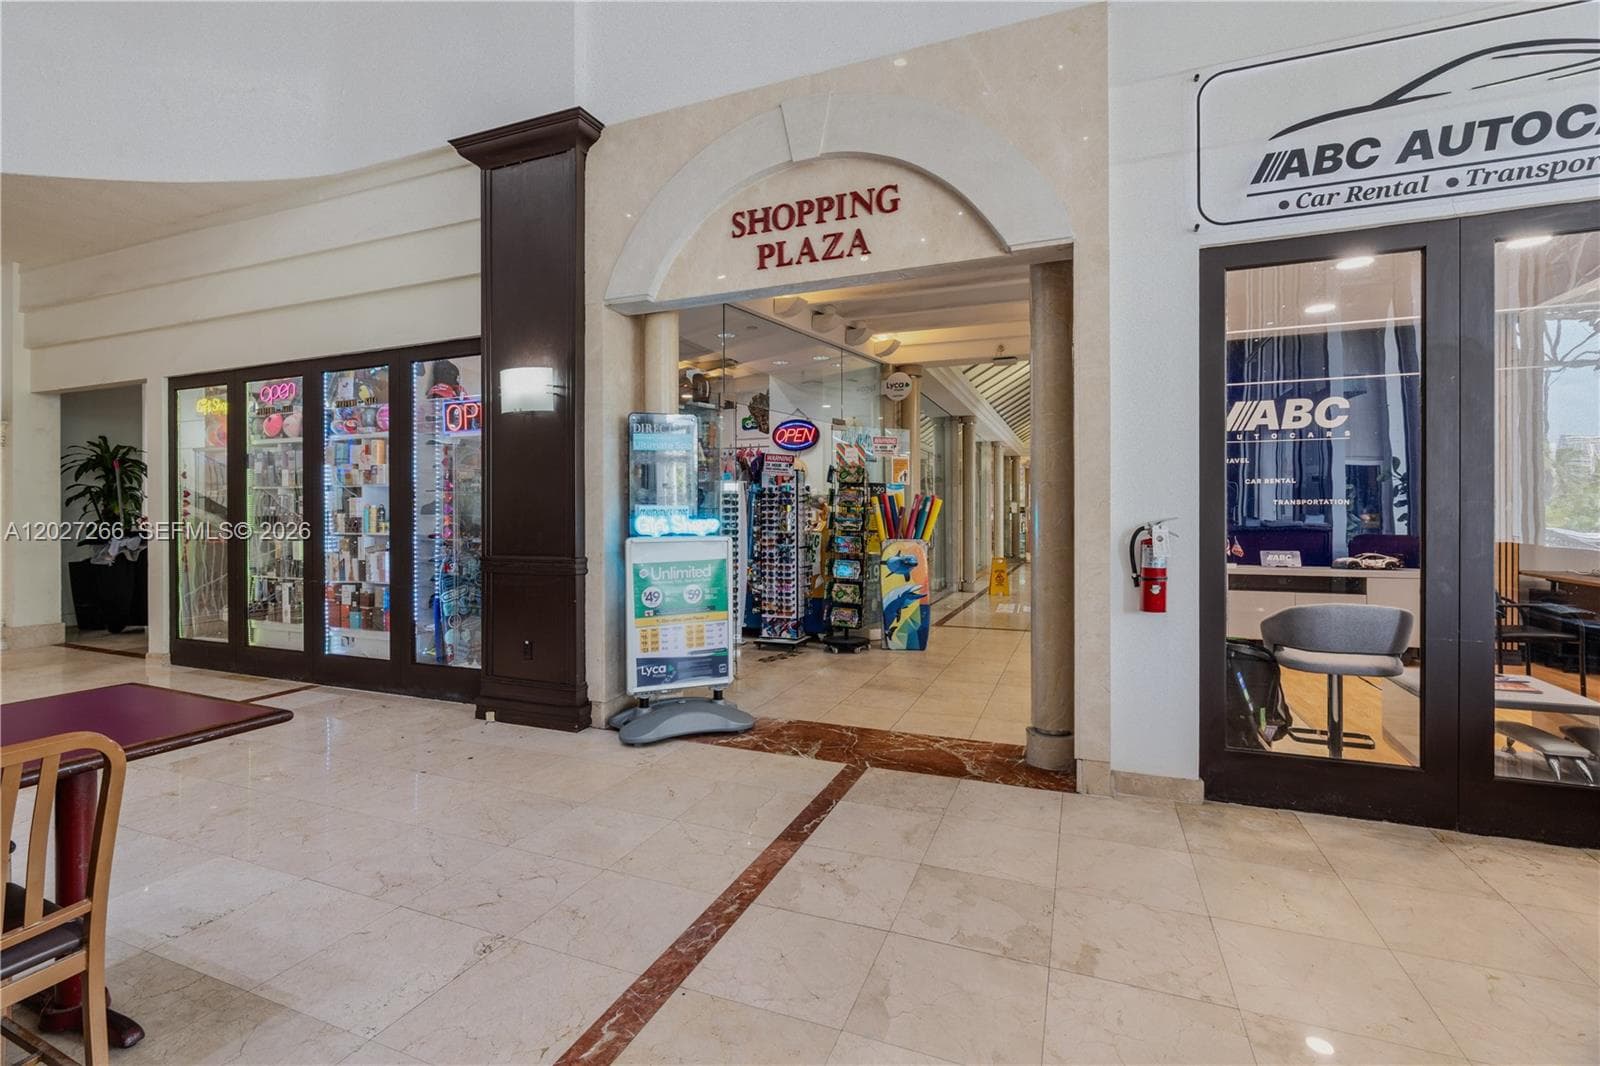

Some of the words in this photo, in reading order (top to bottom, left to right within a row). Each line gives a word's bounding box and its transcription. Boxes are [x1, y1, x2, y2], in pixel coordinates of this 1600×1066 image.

[1275, 137, 1382, 181] ABC
[1395, 103, 1600, 165] AUTOC
[1295, 190, 1341, 209] Car
[1345, 175, 1430, 204] Rental
[731, 184, 901, 239] SHOPPING
[756, 228, 872, 270] PLAZA
[260, 381, 296, 406] open
[886, 381, 904, 390] Lyca
[446, 402, 482, 432] OP
[1243, 396, 1351, 432] ABC
[775, 427, 816, 444] OPEN
[766, 454, 793, 462] WARNING
[1264, 477, 1297, 485] RENTAL
[1272, 498, 1351, 506] TRANSPORTATION
[650, 564, 712, 581] Unlimited
[641, 664, 667, 677] Lyca
